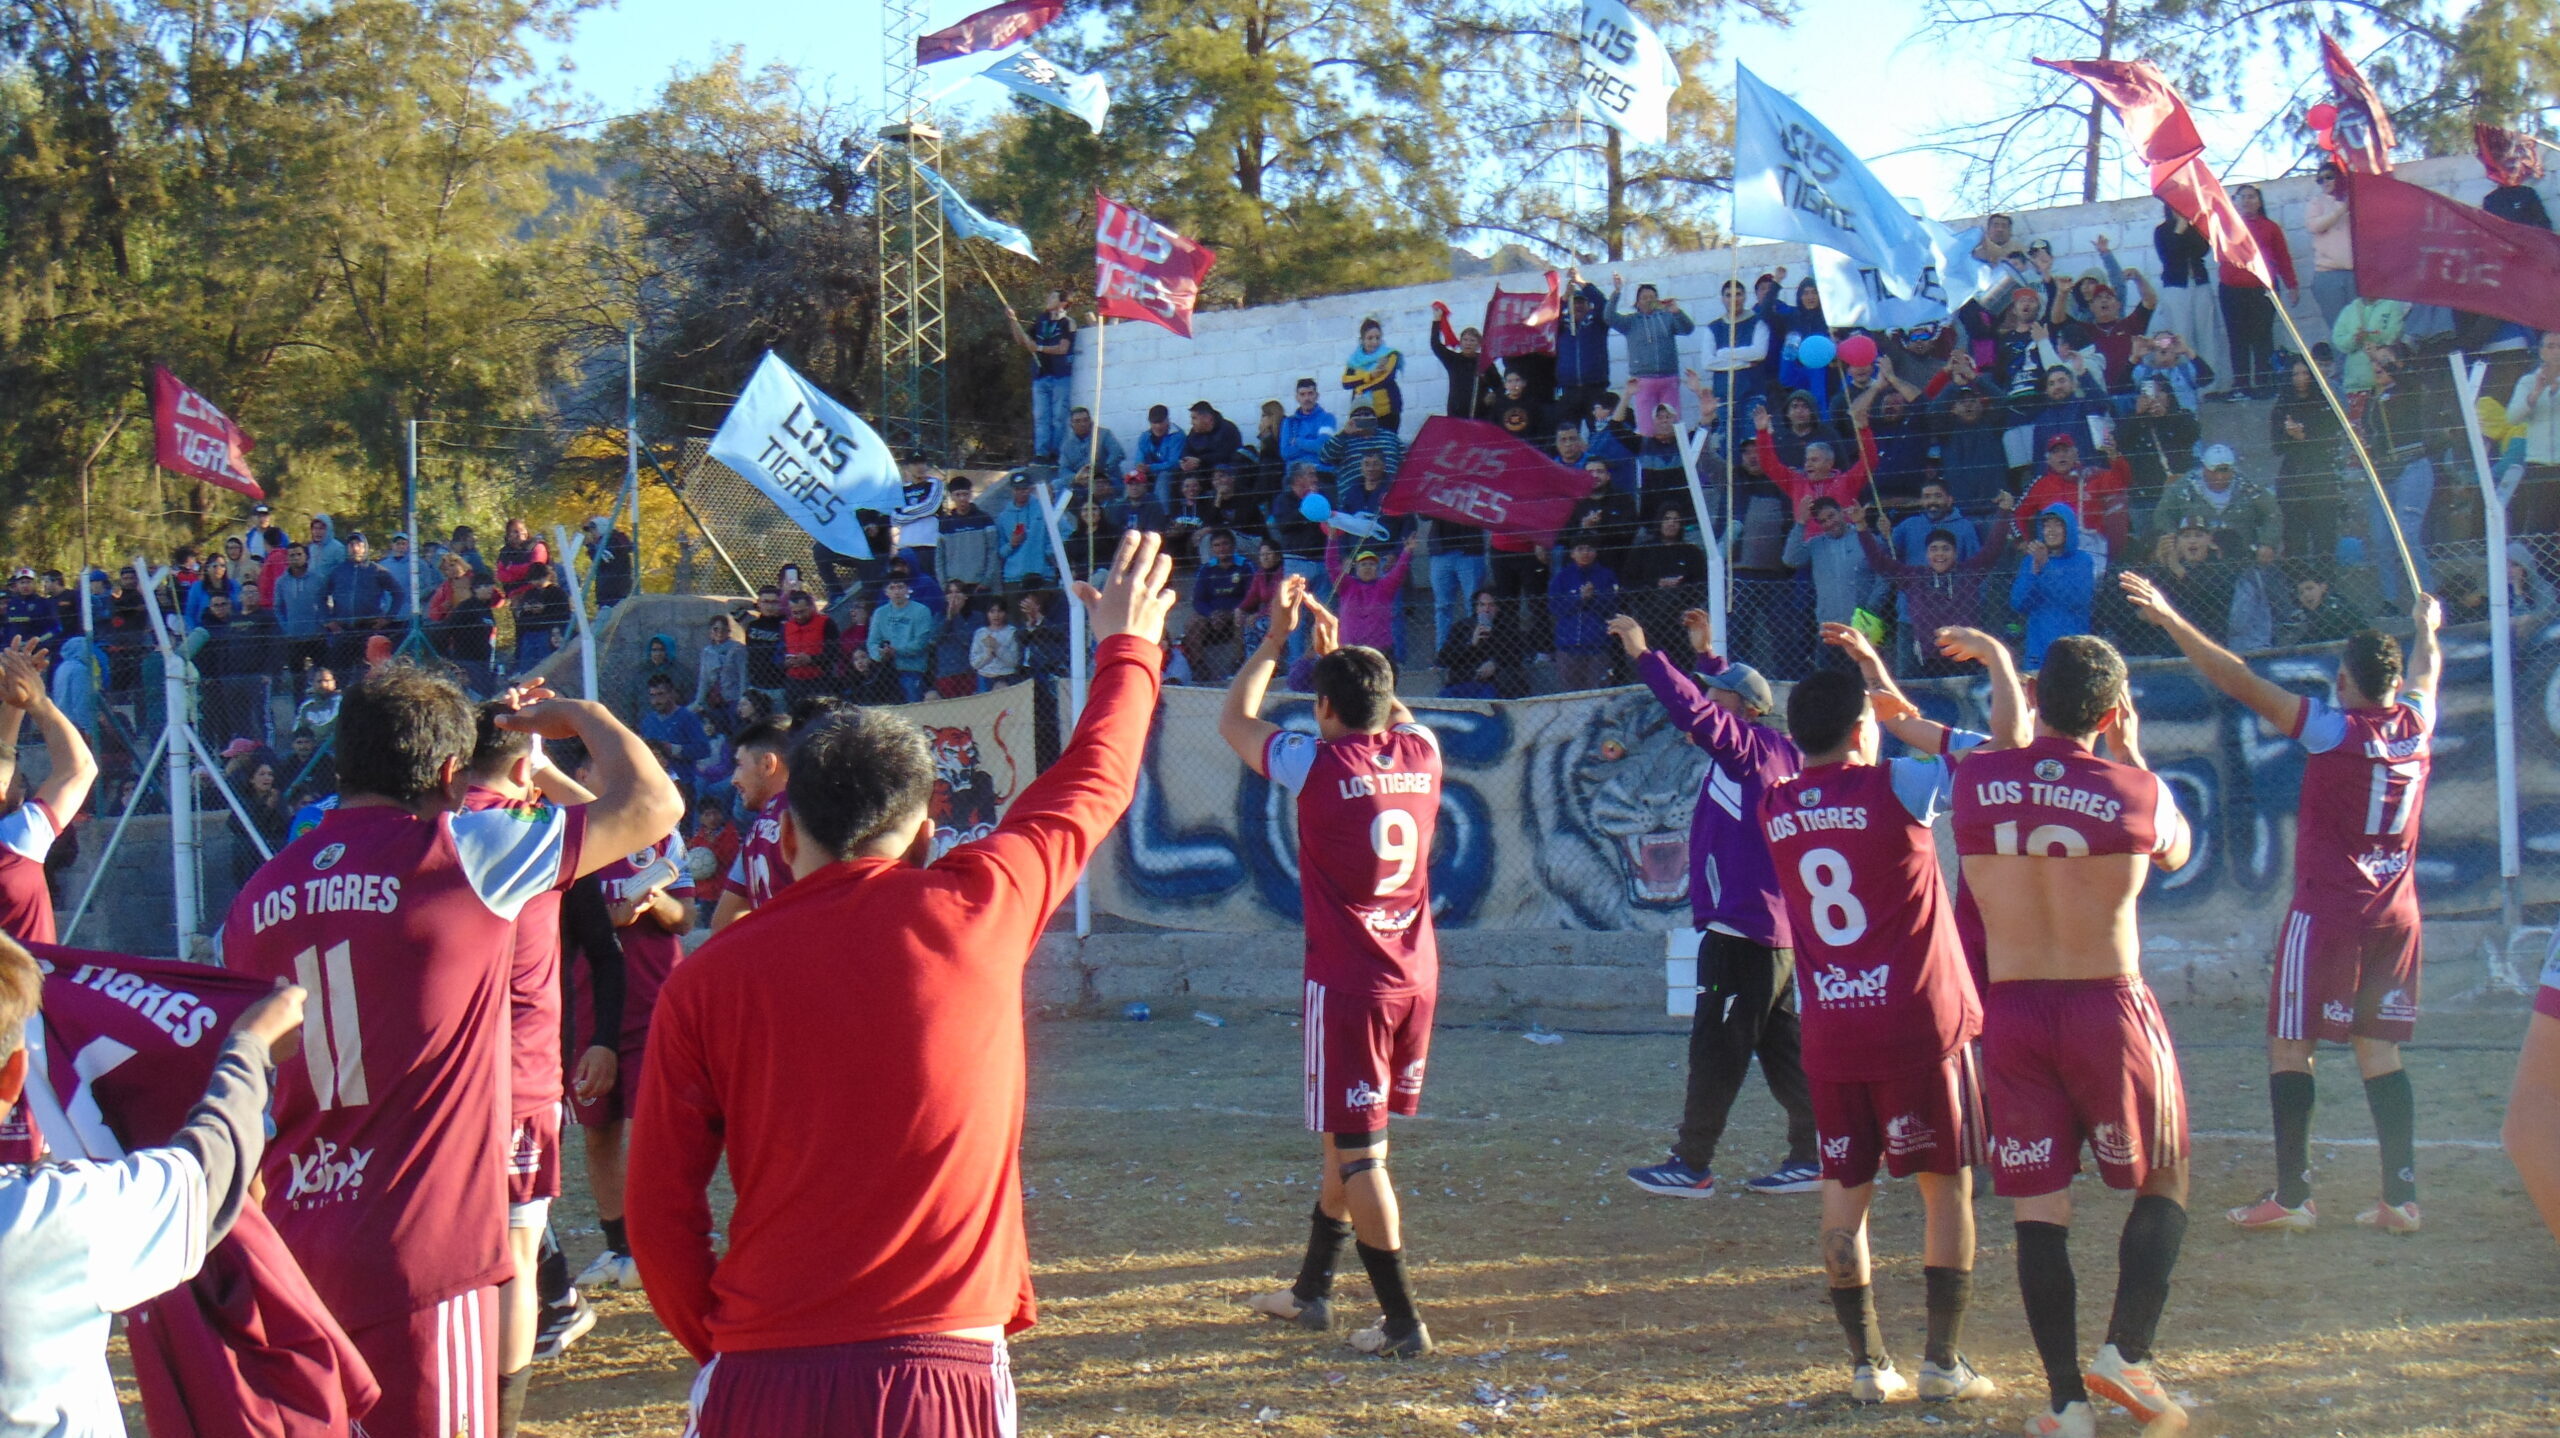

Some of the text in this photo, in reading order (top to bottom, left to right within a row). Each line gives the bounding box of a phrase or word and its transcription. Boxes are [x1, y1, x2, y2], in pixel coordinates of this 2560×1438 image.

[1096, 203, 1179, 264] LOS
[781, 401, 859, 475] LOS
[1433, 440, 1514, 478] LOS
[757, 434, 846, 527] TIGRES
[1338, 774, 1377, 800] LOS
[1976, 781, 2121, 823] LOS TIGRES
[1369, 808, 1419, 896] 9
[1766, 806, 1868, 843] LOS TIGRES
[253, 873, 401, 935] LOS TIGRES
[1798, 848, 1868, 947] 8
[70, 964, 218, 1048] TIGRES
[294, 939, 370, 1112] 11
